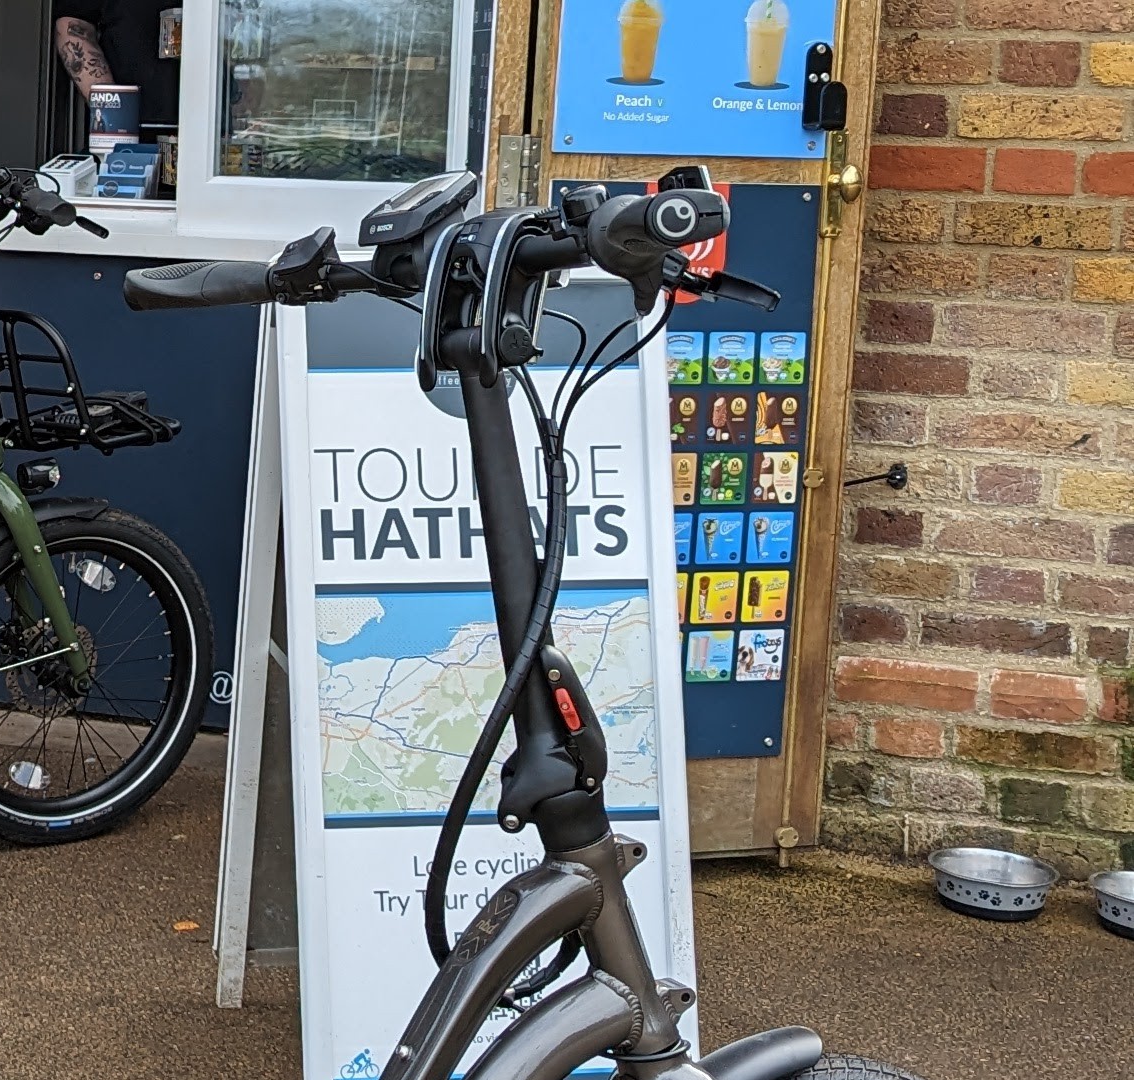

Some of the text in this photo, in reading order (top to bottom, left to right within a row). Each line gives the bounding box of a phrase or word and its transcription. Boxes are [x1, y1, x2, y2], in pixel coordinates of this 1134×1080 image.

[616, 95, 652, 106] Peach
[713, 97, 803, 111] Orange & Lemon
[603, 112, 669, 123] No Added Sugar
[377, 223, 394, 232] BOSCH
[313, 445, 625, 502] TOU DE
[414, 855, 467, 877] Loe
[373, 890, 411, 917] Try
[415, 889, 469, 911] Tur
